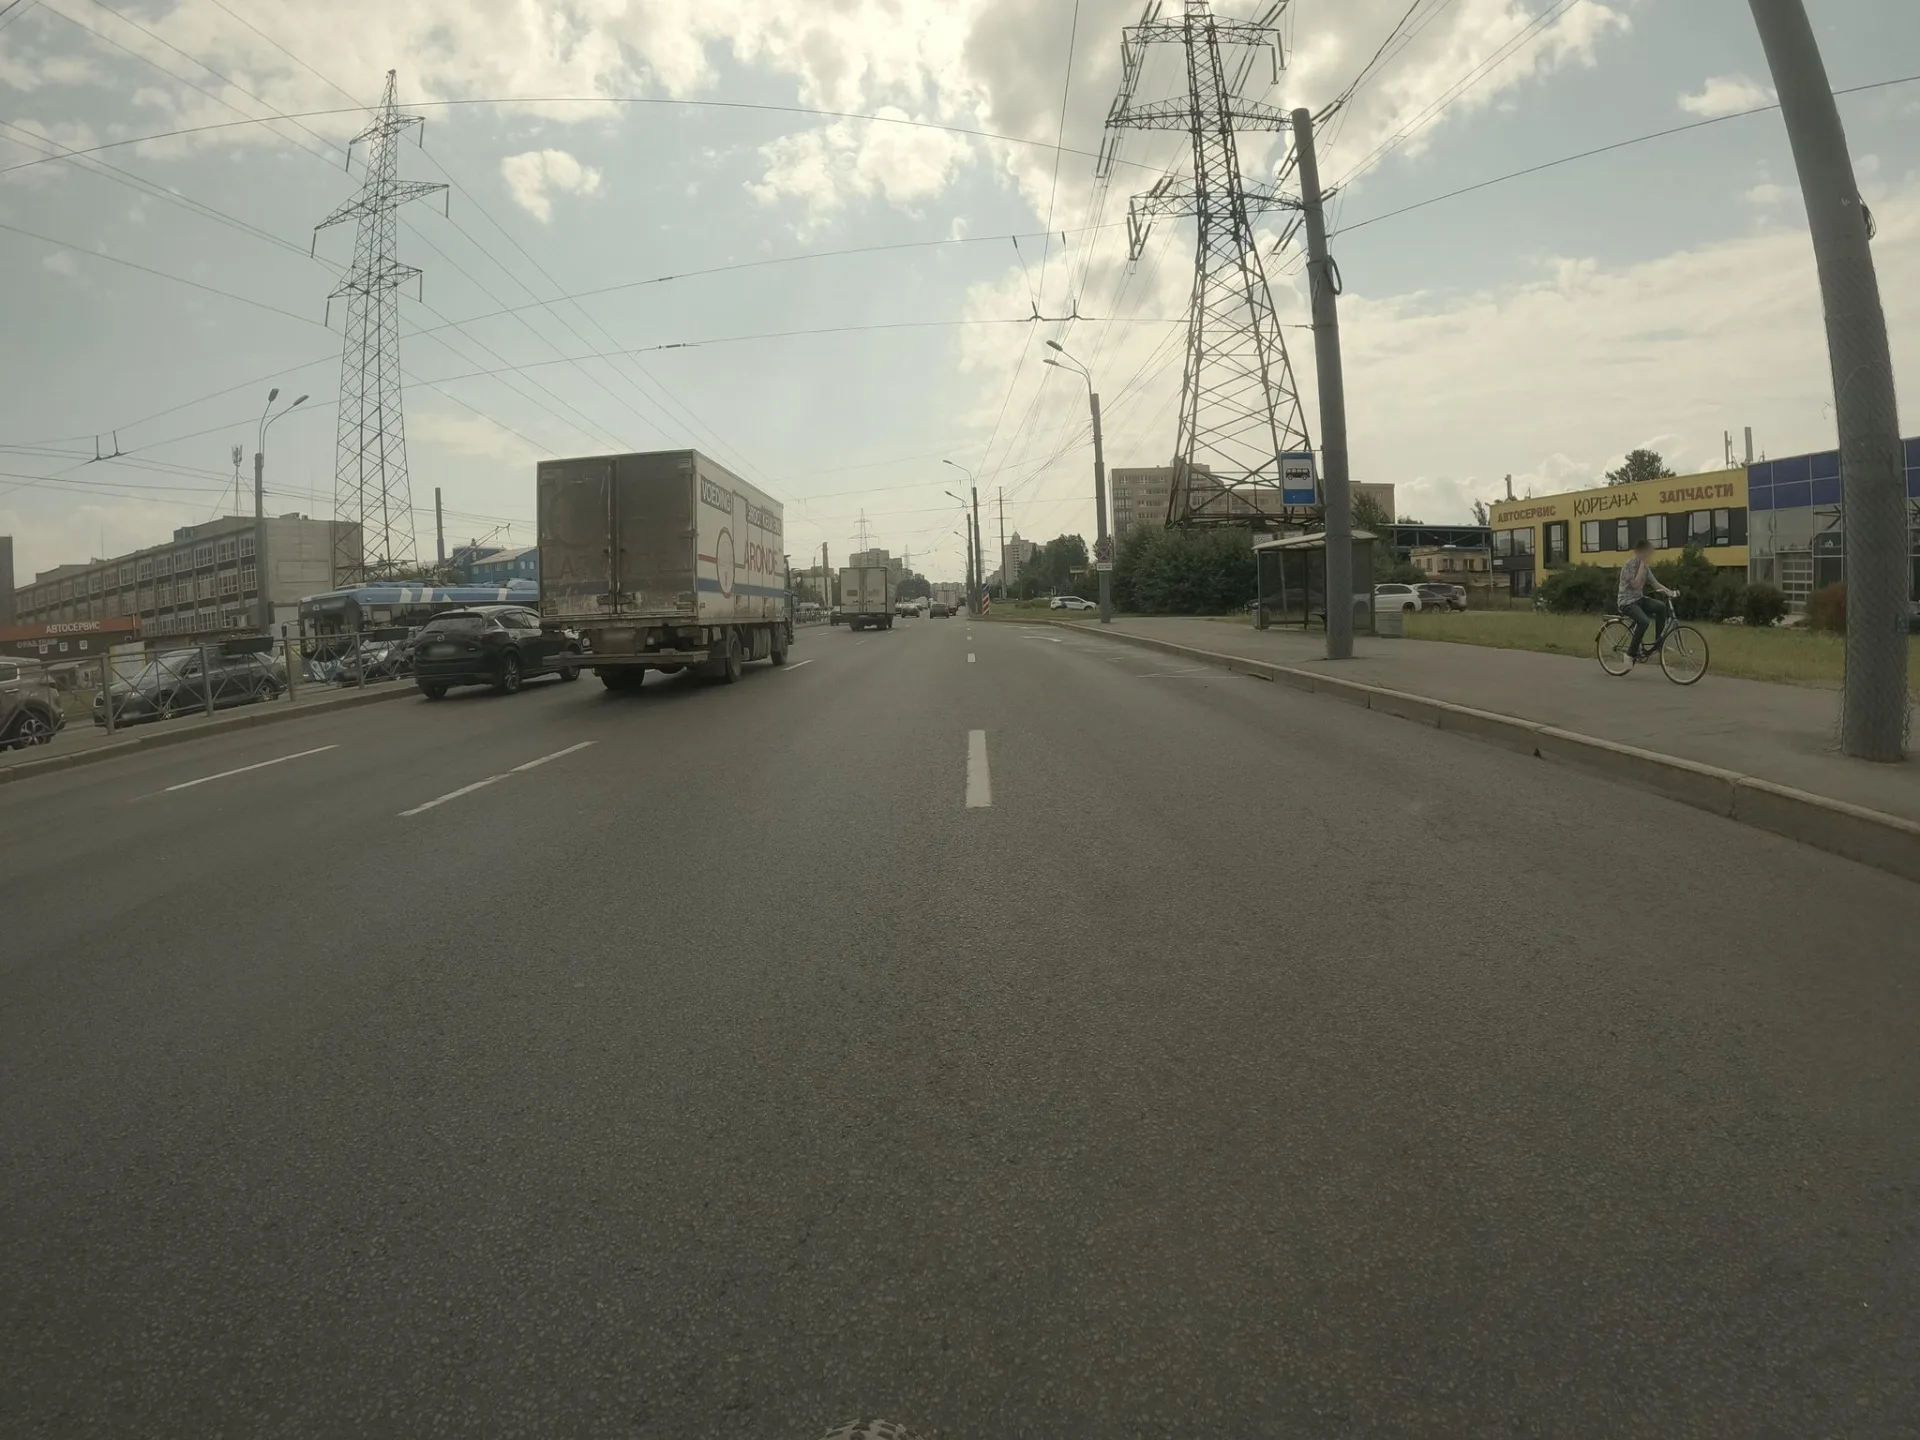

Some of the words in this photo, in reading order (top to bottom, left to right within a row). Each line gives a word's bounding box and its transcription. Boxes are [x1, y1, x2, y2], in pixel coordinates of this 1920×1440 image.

[1497, 505, 1556, 523] АВТОСЕРВИС
[1573, 491, 1639, 518] КОРЕАНА
[1659, 483, 1734, 504] ЗАПЧАСТИ
[45, 621, 100, 634] АВТОСЕРВИС
